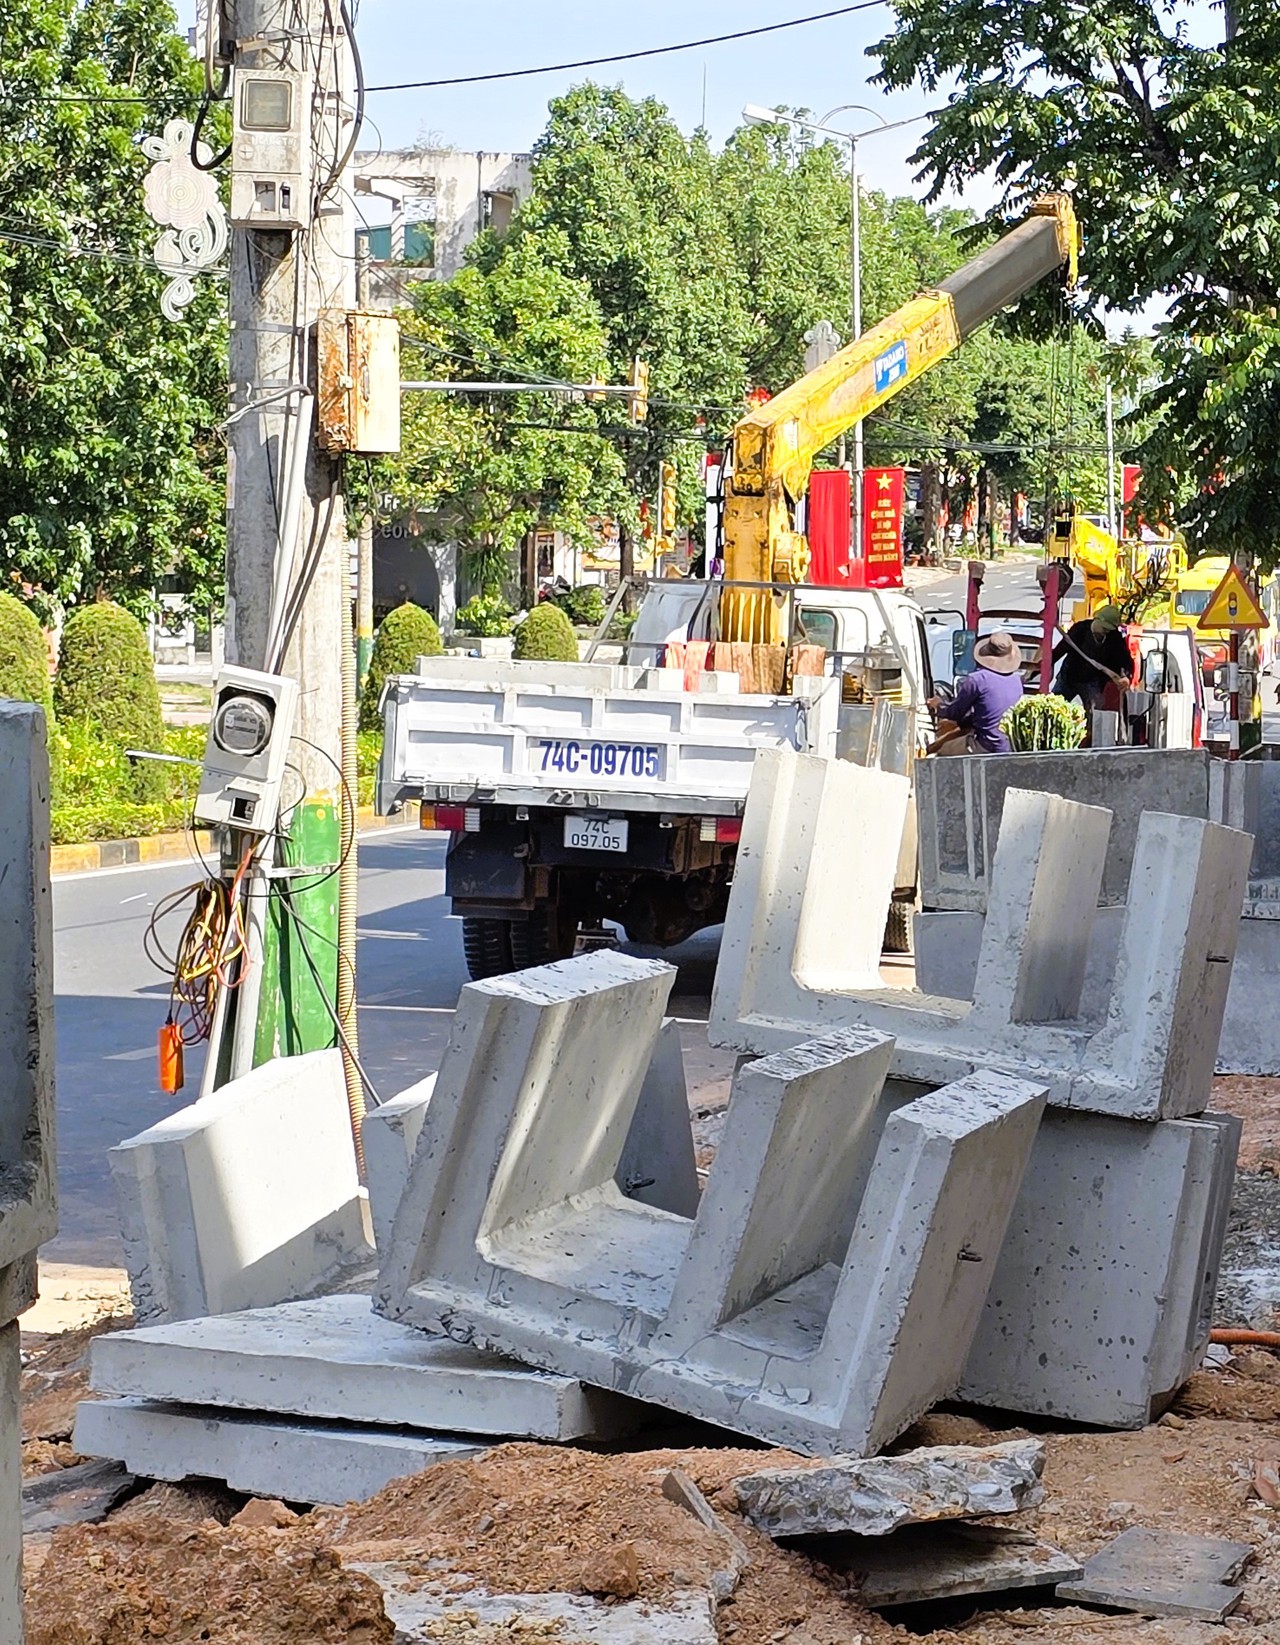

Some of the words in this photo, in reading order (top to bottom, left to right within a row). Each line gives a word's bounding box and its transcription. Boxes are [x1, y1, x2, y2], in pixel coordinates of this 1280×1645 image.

[540, 741, 659, 776] 74C-09705
[584, 819, 610, 834] 74C
[571, 834, 621, 850] 097.05
